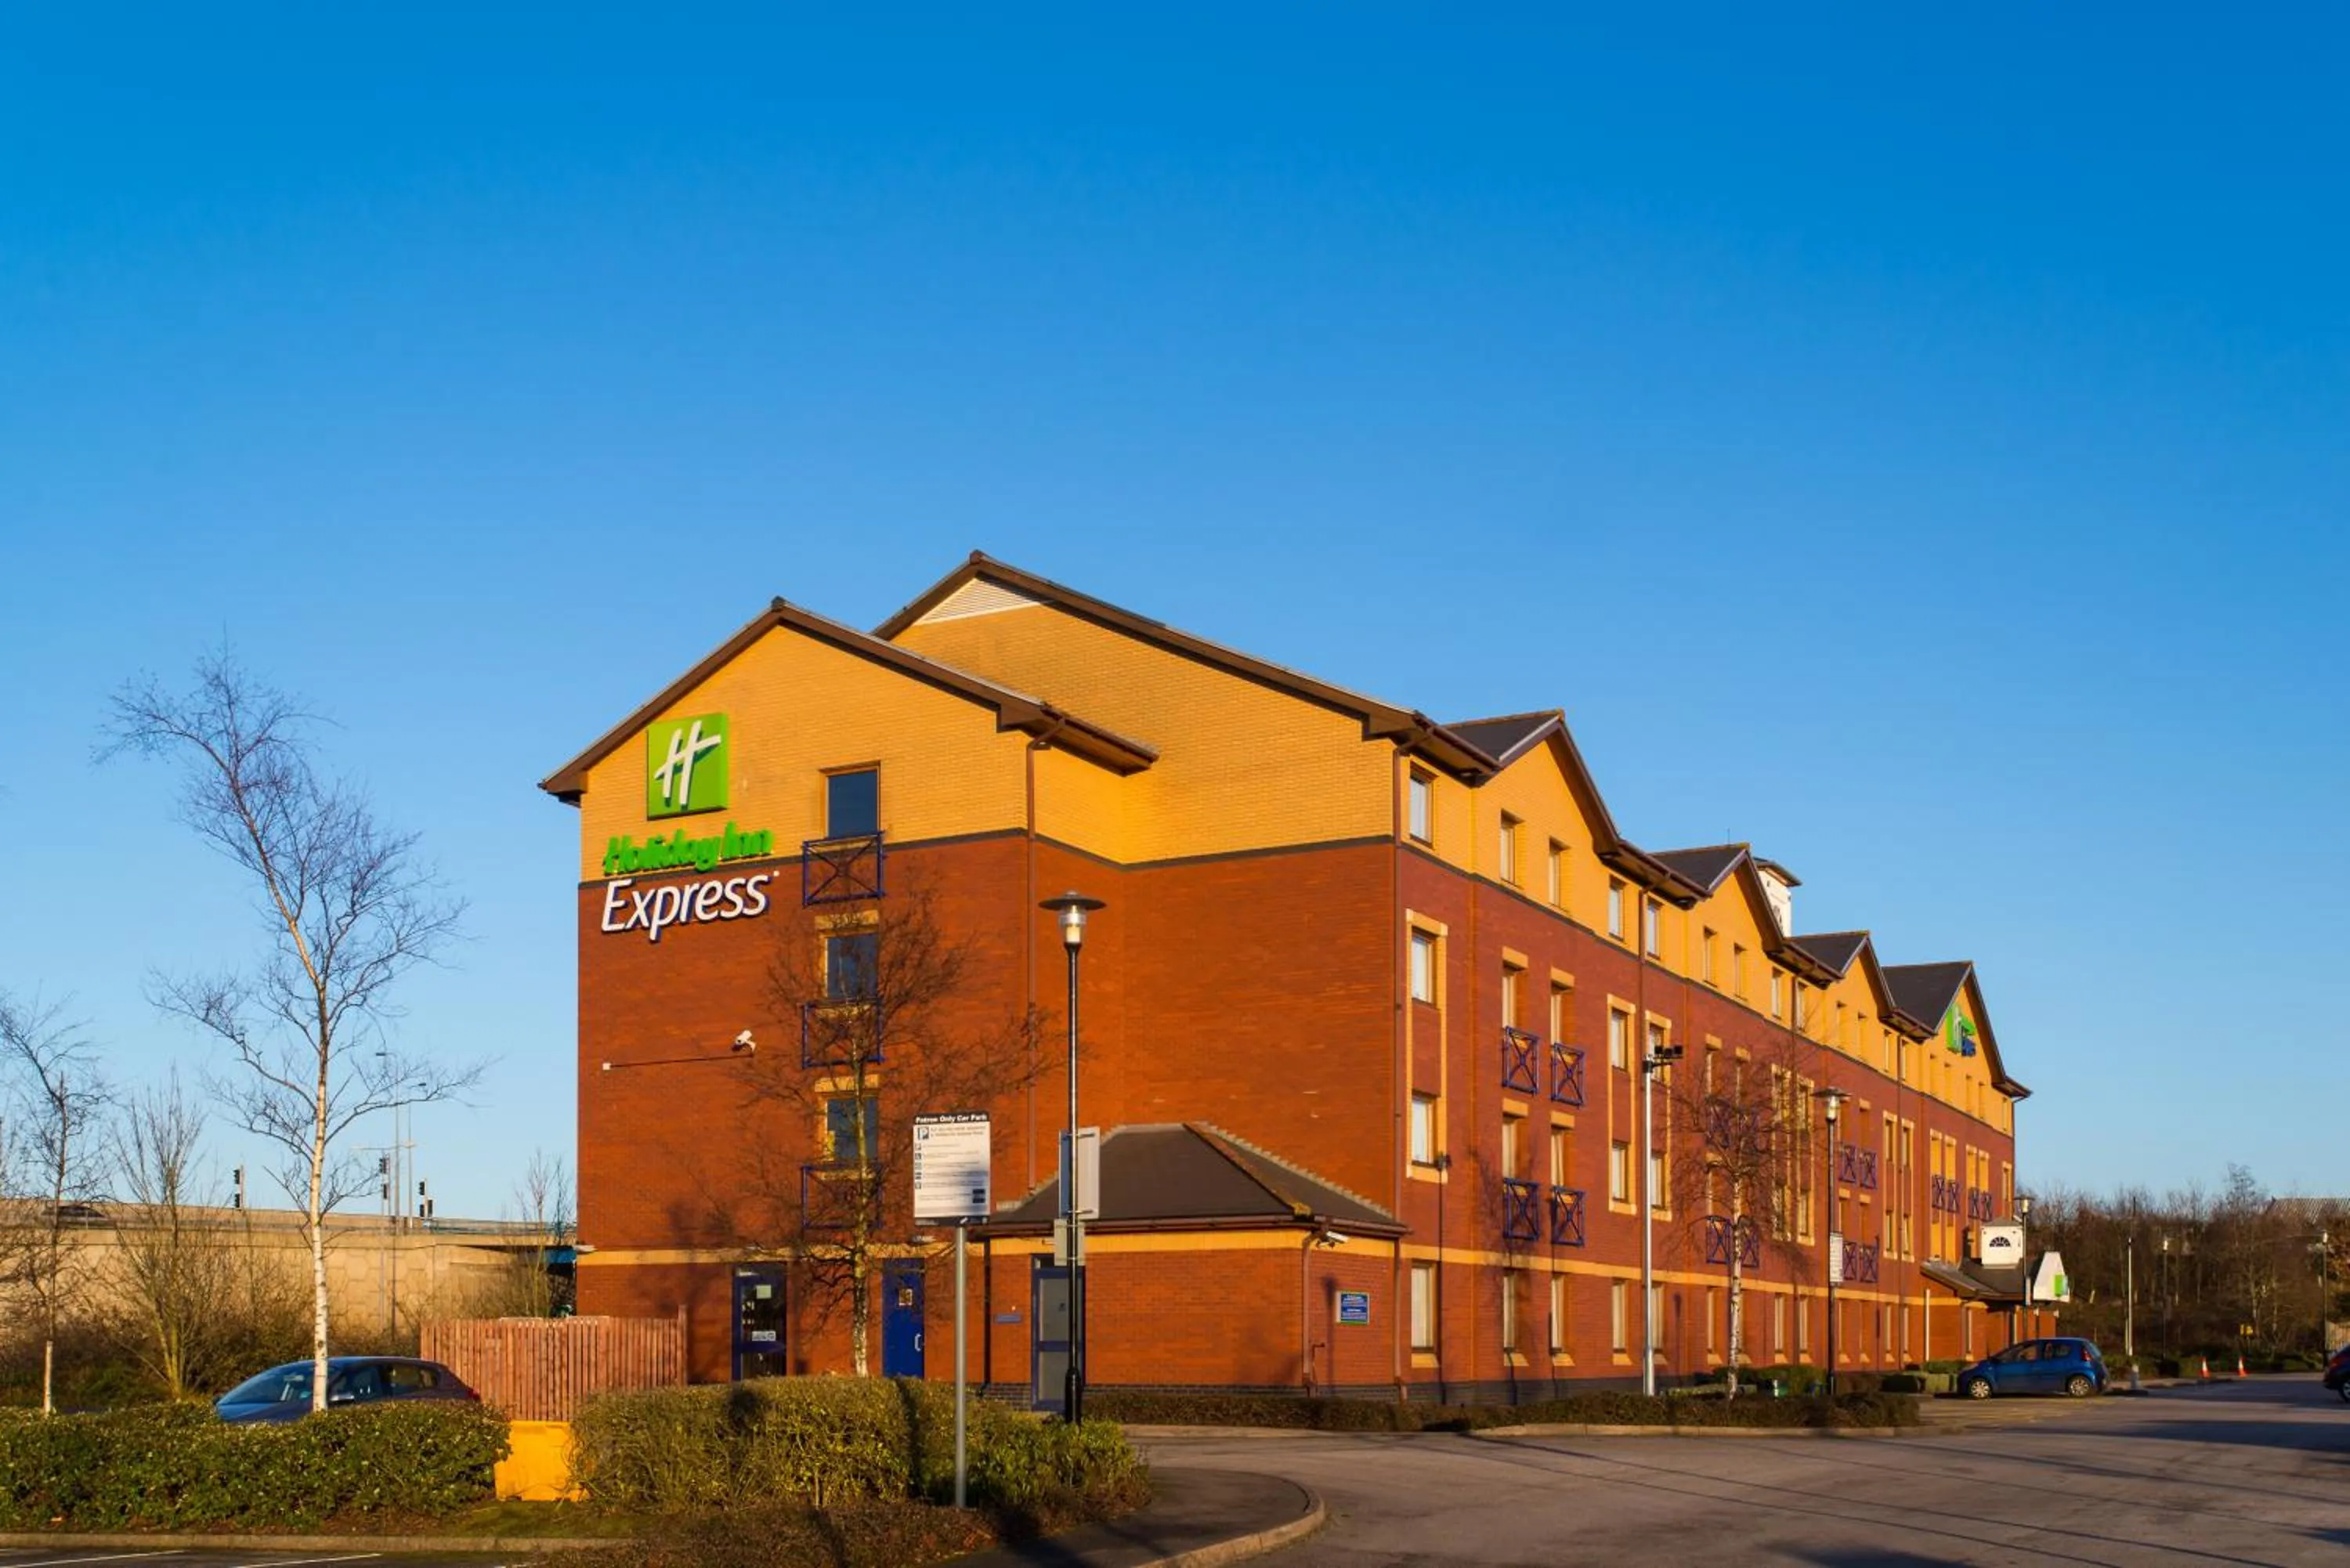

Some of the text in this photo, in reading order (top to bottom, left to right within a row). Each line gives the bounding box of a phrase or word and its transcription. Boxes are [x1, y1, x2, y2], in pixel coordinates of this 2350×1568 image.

[602, 821, 774, 876] Holiday Inn
[601, 873, 770, 942] Express
